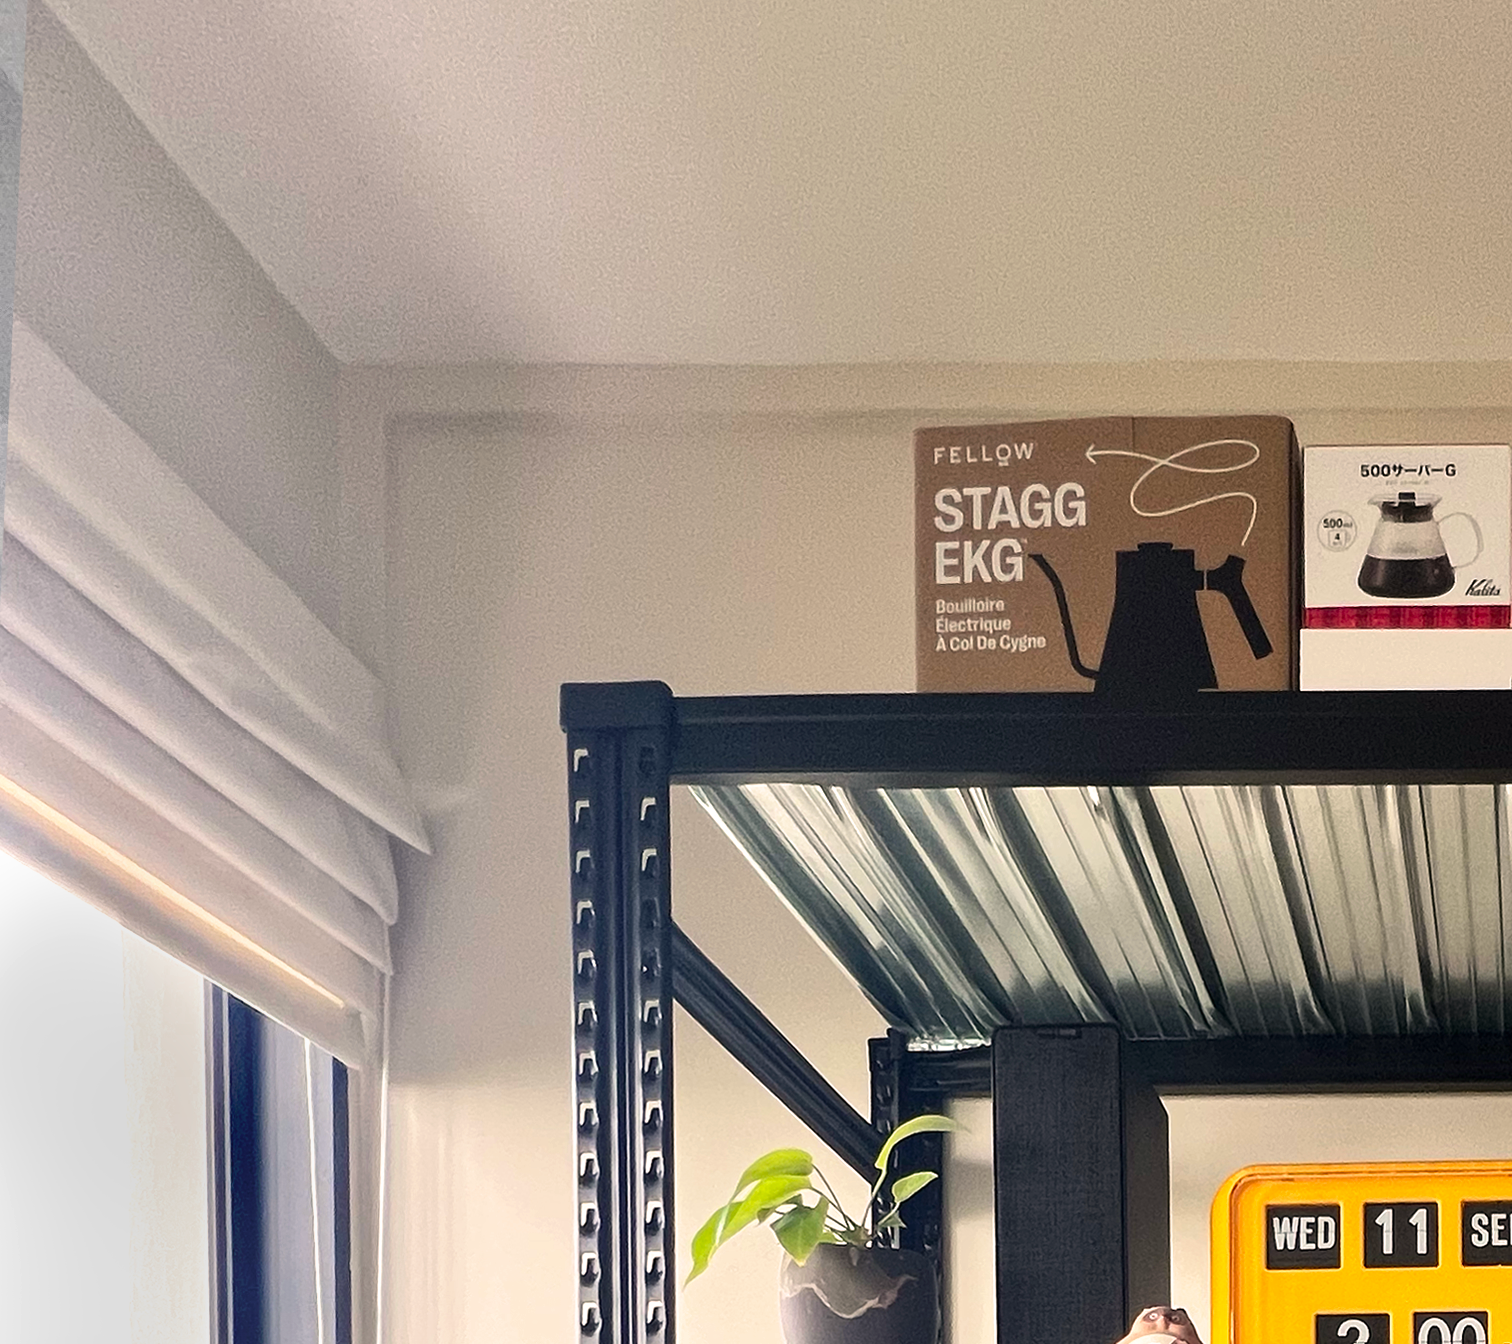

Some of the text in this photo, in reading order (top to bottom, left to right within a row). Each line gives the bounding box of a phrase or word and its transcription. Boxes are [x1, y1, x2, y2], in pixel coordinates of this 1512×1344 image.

[933, 443, 1034, 465] FELLOW
[1360, 463, 1456, 478] 500サーバーG
[934, 482, 1086, 532] STAGG
[936, 598, 1005, 614] Bouilloire
[936, 615, 1011, 634] Électrique
[936, 634, 1046, 652] À Col De Cygne
[1272, 1215, 1336, 1251] WED
[1374, 1208, 1429, 1255] 11
